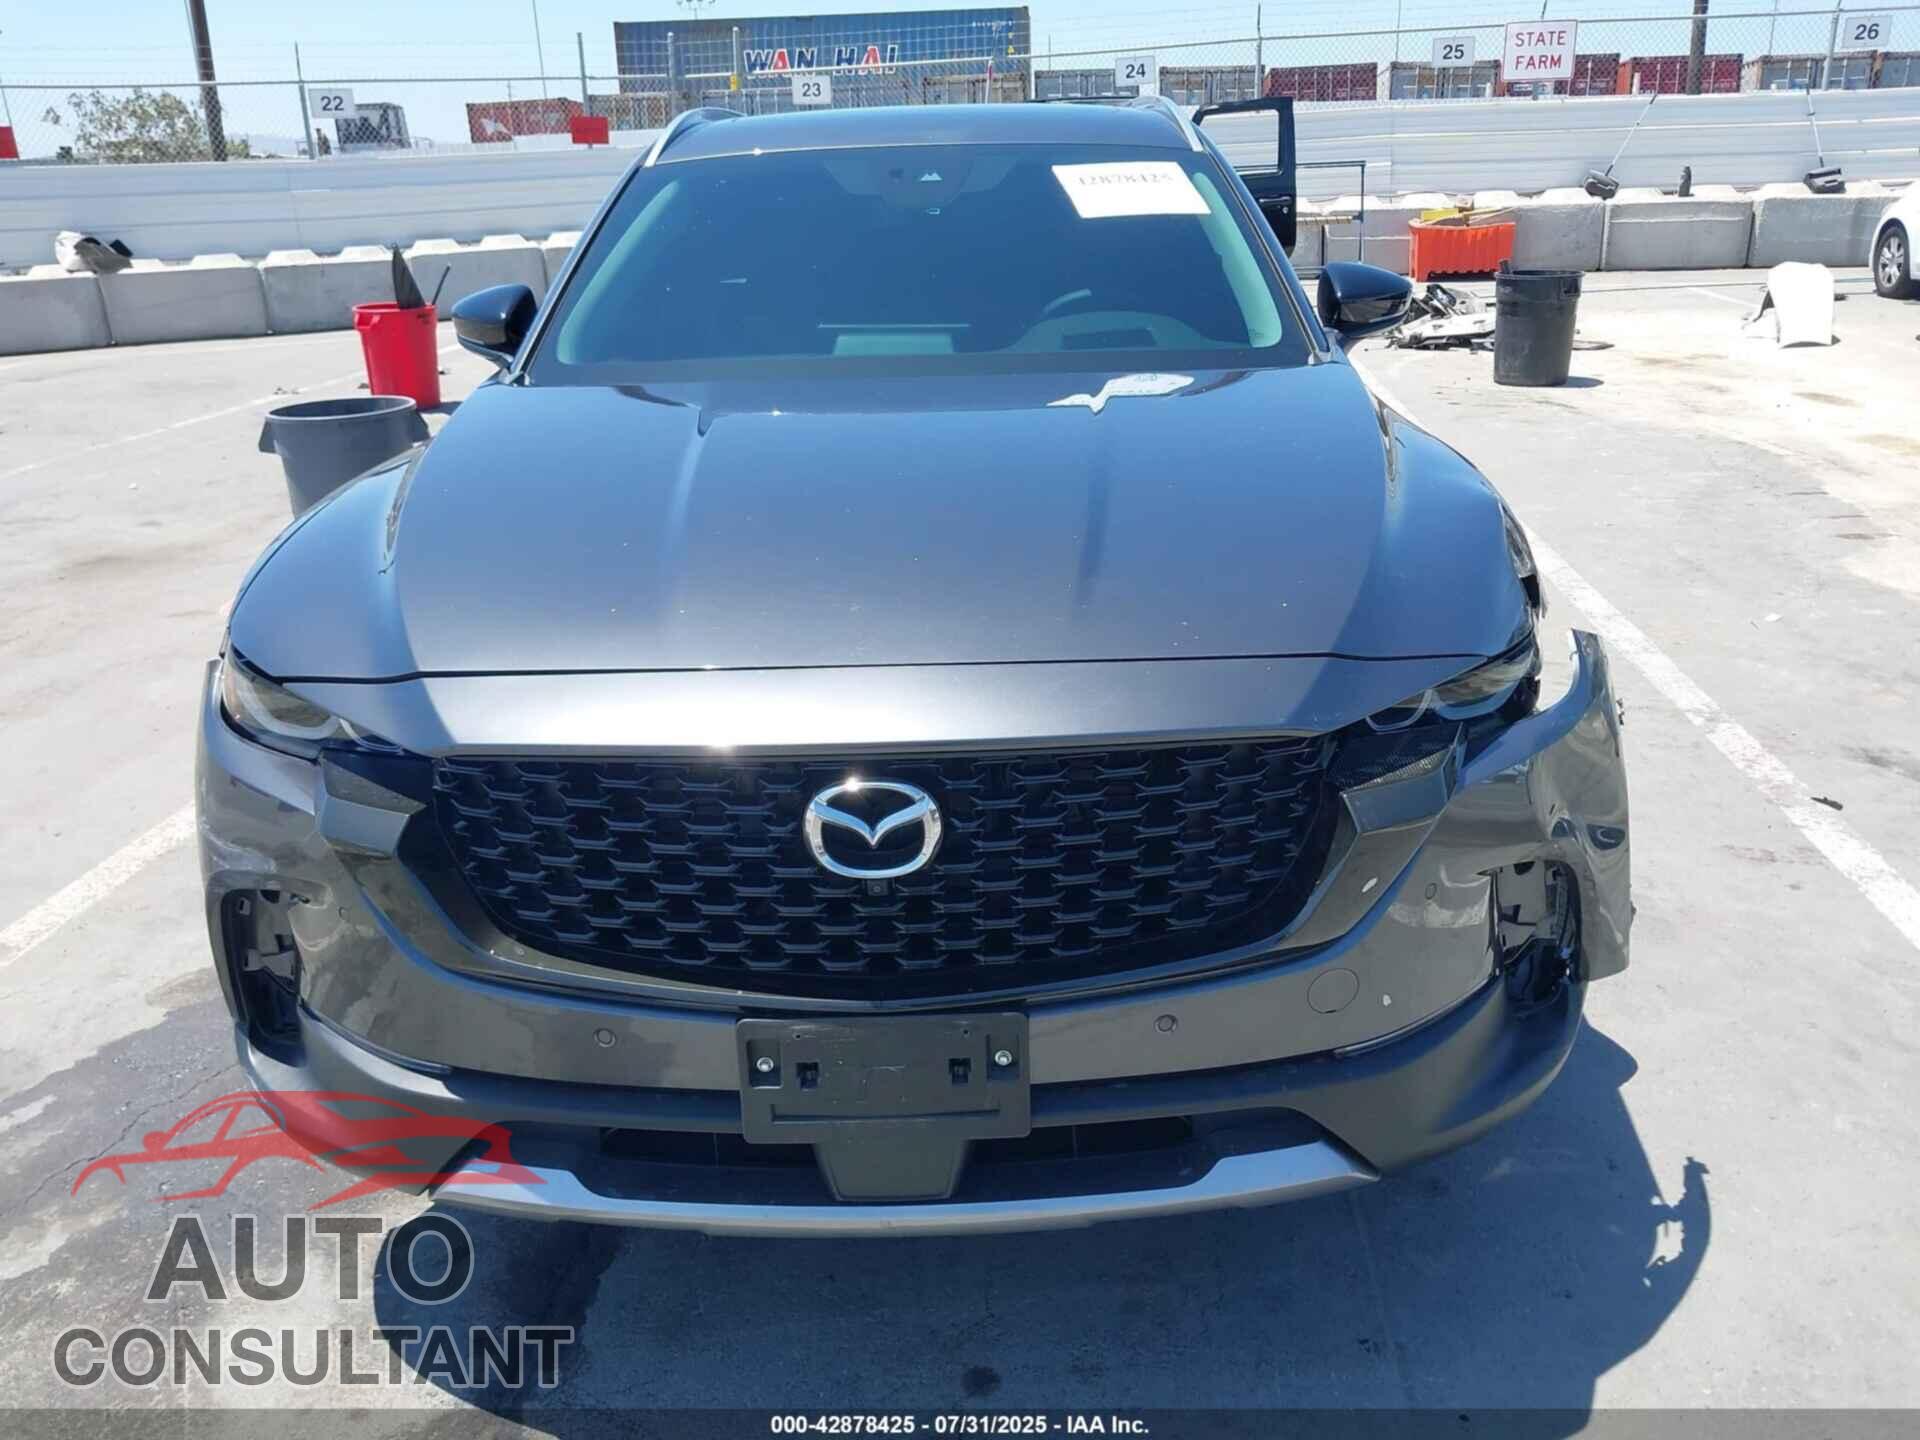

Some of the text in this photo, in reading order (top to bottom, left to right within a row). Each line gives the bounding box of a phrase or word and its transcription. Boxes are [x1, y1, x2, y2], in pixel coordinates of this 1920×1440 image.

[1514, 30, 1567, 47] STATE
[1854, 23, 1880, 40] 26
[1442, 44, 1465, 60] 25
[744, 44, 899, 79] WAN HAI
[1514, 54, 1562, 70] FARM
[1126, 63, 1146, 79] 24
[802, 82, 822, 98] 23
[320, 95, 345, 111] 22
